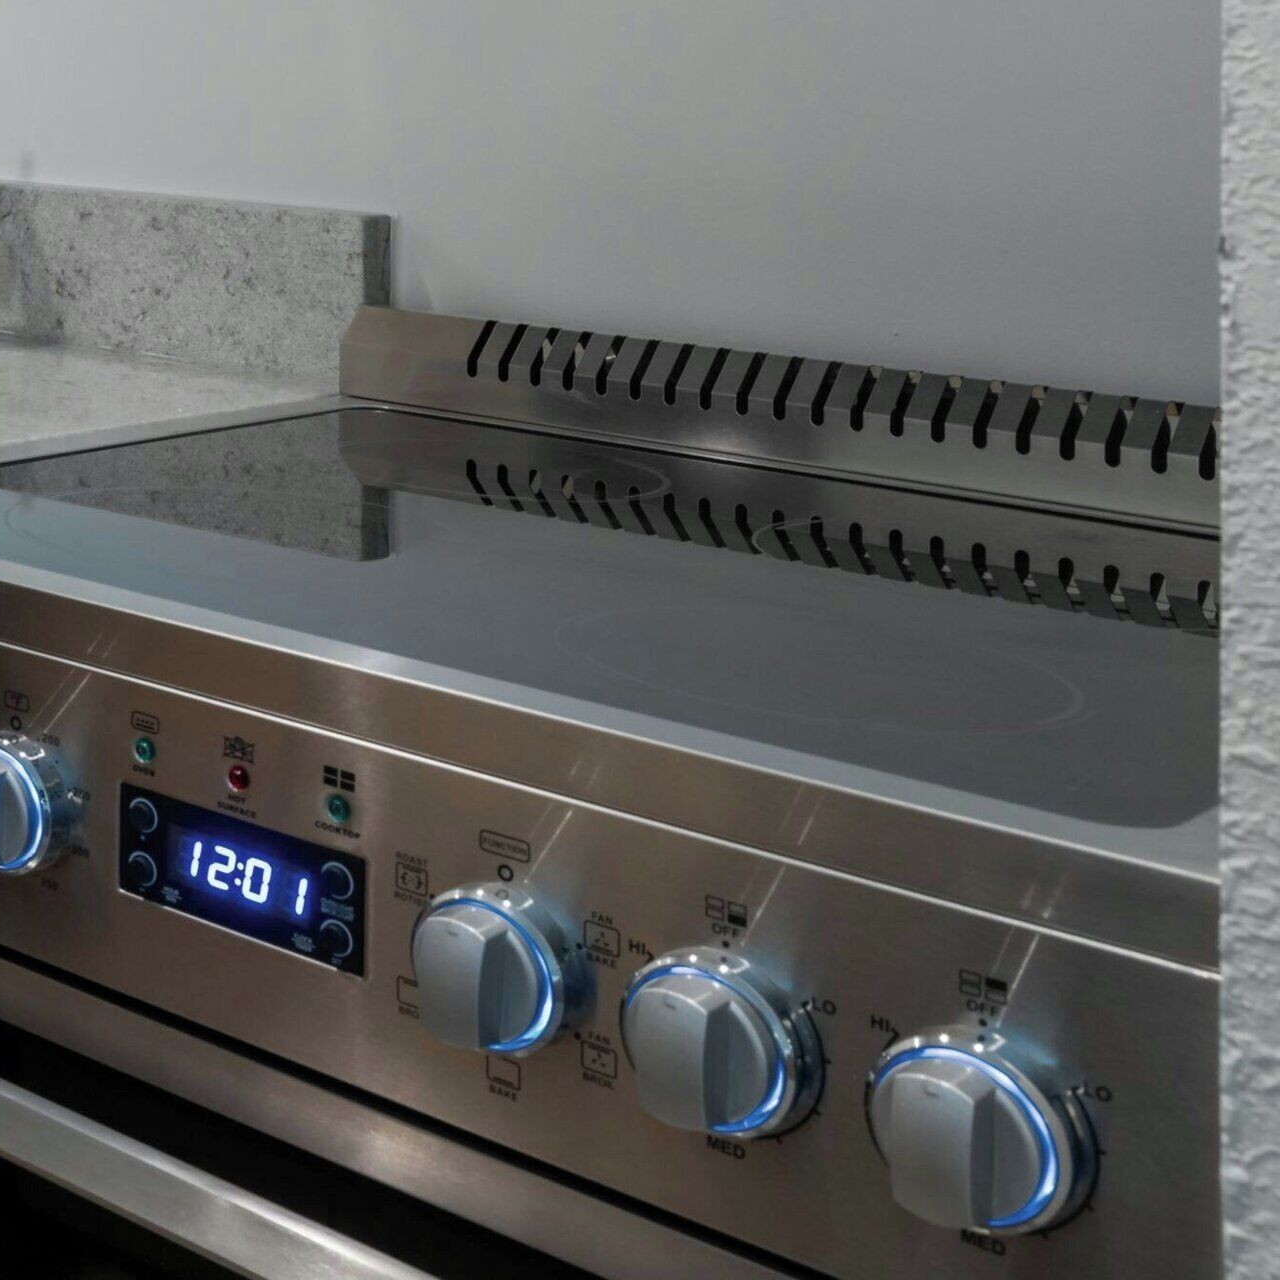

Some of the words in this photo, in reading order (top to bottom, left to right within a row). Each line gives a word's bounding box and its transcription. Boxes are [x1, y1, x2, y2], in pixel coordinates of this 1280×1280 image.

[228, 793, 246, 804] HOT
[217, 801, 256, 819] SURFACE
[314, 820, 360, 840] COOKTOP
[482, 836, 527, 856] FUNCTION
[395, 851, 428, 868] ROAST
[190, 840, 309, 916] 12:01
[591, 911, 613, 925] FAN
[712, 923, 740, 938] OFF
[629, 939, 646, 956] HI
[586, 951, 616, 969] BAKE
[398, 1005, 420, 1019] BRO
[811, 996, 837, 1015] LO
[966, 999, 999, 1017] OFF
[870, 1014, 890, 1033] HI
[589, 1031, 610, 1045] FAN
[489, 1083, 518, 1102] BAKE
[1084, 1080, 1113, 1102] LO
[706, 1134, 745, 1160] MED
[960, 1228, 1006, 1256] MED
